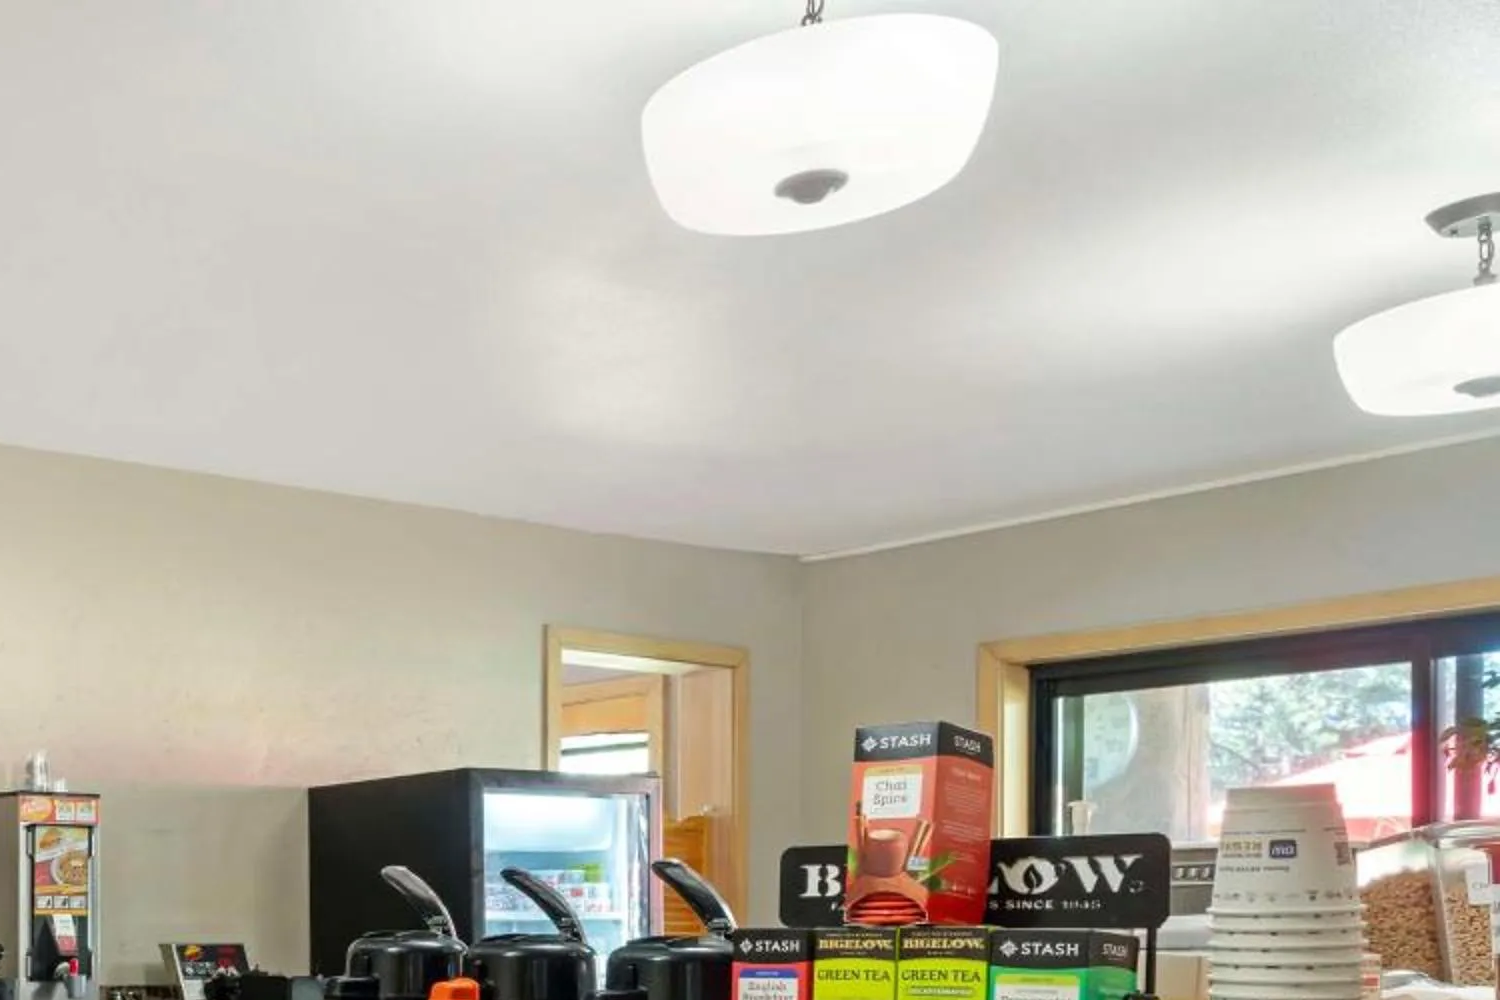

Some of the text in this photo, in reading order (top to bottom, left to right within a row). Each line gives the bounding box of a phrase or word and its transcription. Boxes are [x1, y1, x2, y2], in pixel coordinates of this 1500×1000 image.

[879, 733, 932, 749] STASH
[875, 779, 907, 792] Chai
[873, 793, 908, 807] Spice
[1004, 899, 1054, 910] SINCE
[755, 939, 800, 953] STASH
[1020, 943, 1079, 957] STASH
[817, 969, 891, 982] GREEN TEA
[901, 969, 981, 983] GREEN TEA
